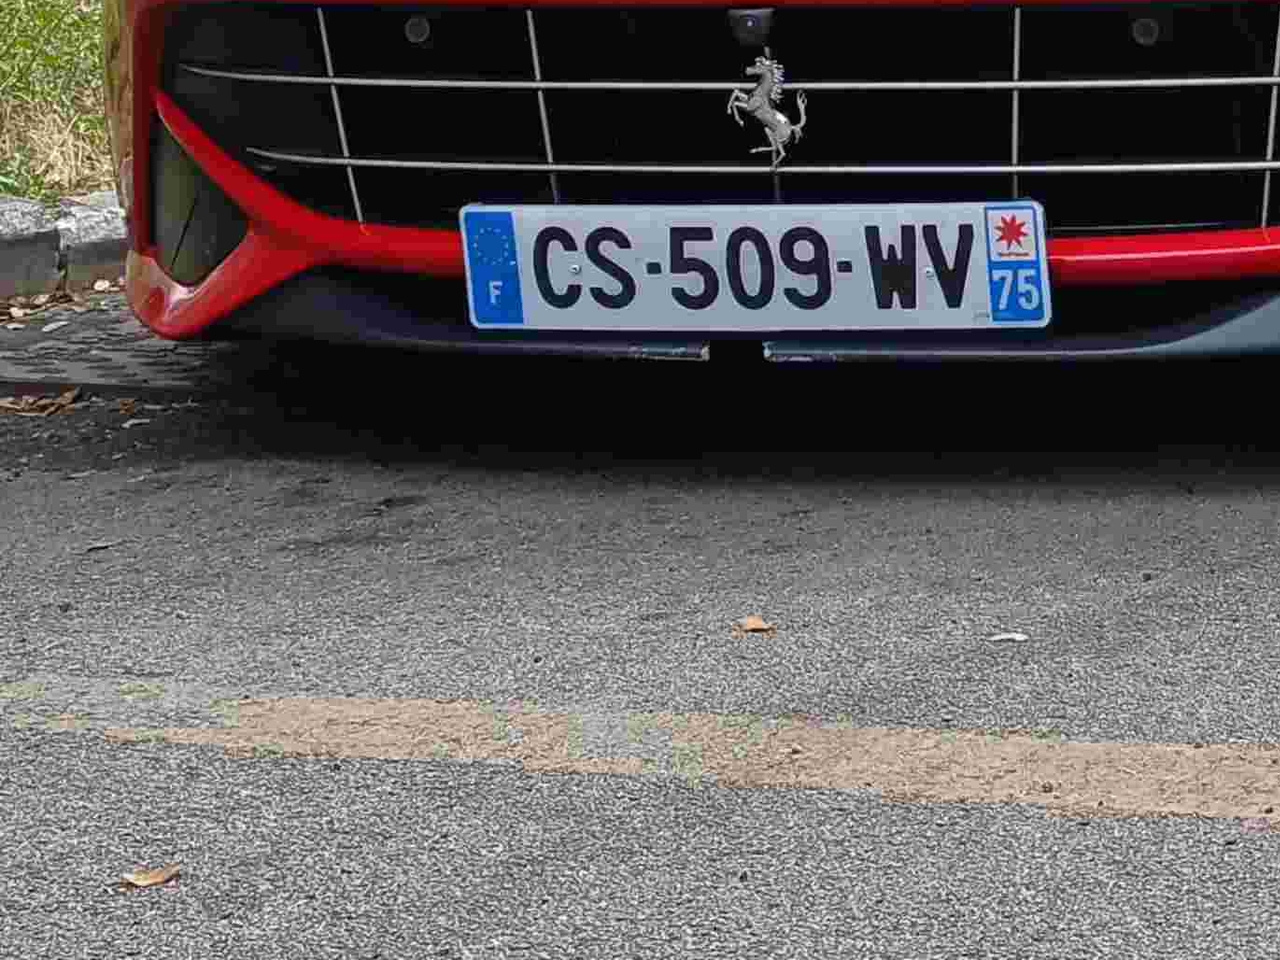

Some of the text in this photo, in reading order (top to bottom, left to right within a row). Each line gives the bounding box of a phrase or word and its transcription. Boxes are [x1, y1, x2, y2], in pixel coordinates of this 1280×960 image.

[533, 224, 974, 311] CS-509-WV
[488, 280, 504, 305] F
[991, 269, 1040, 311] 75
